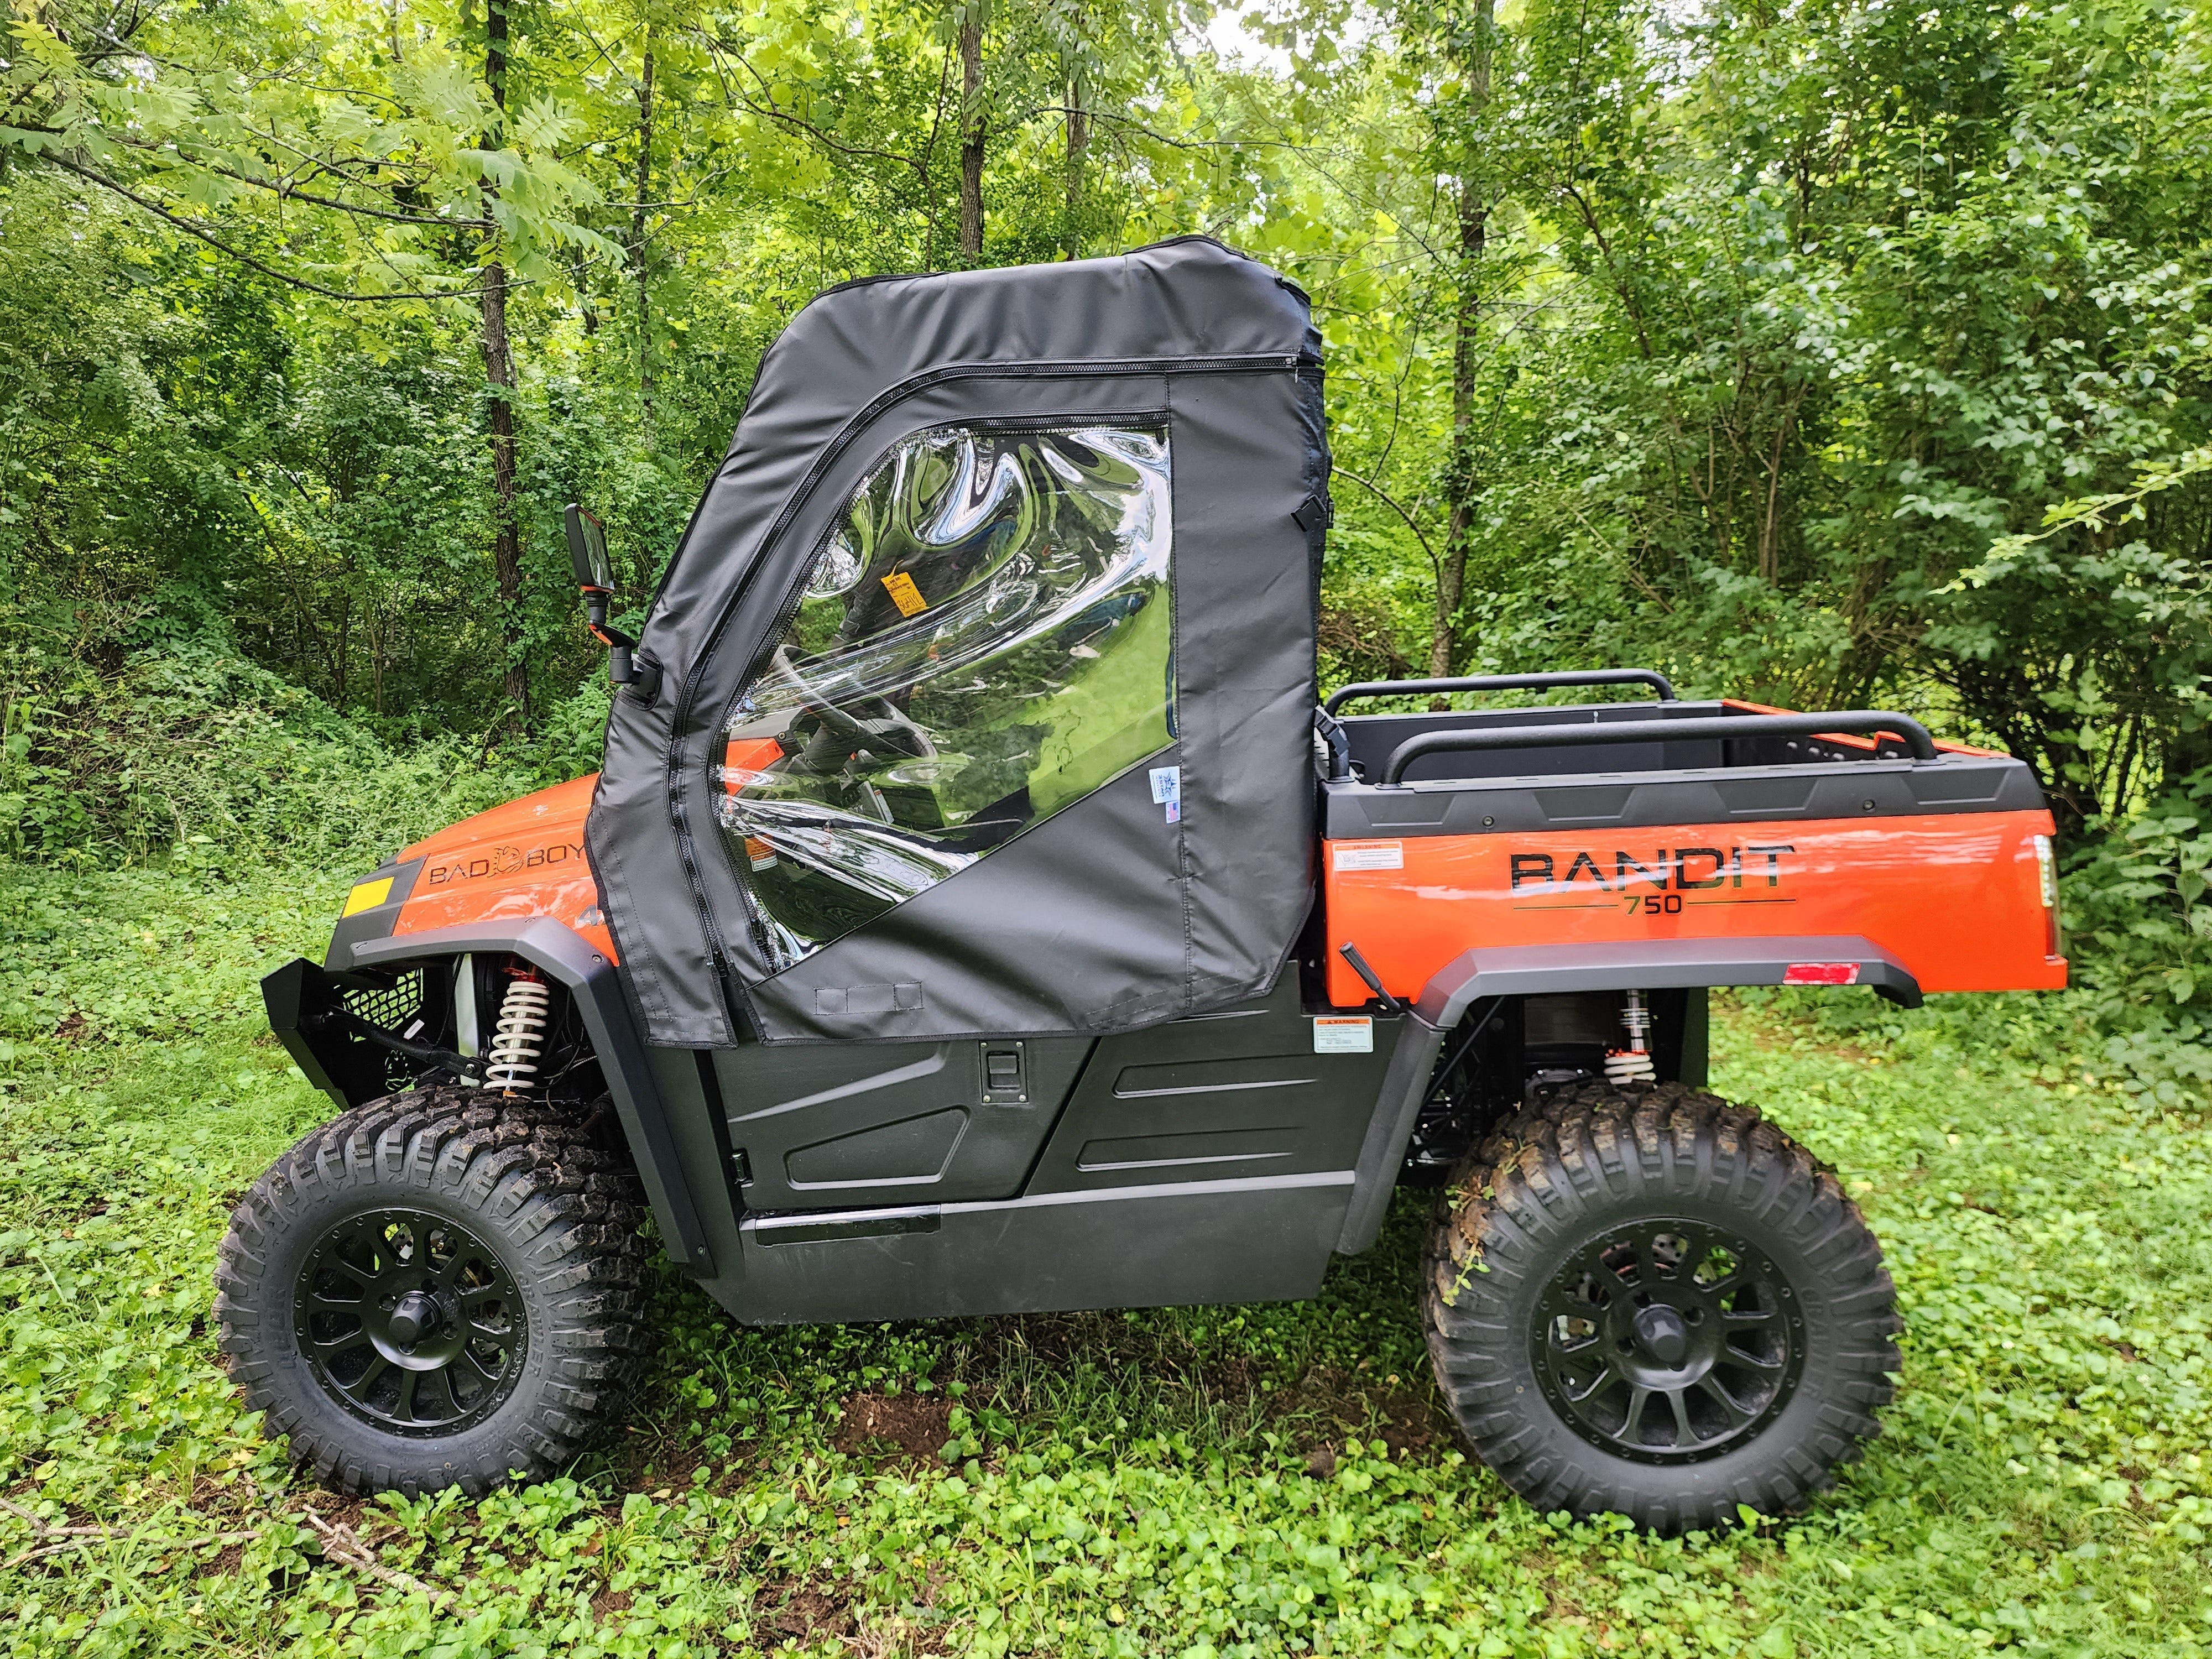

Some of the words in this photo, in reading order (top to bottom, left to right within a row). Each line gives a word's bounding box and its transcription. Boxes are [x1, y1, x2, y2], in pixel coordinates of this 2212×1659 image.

[429, 859, 489, 885] BAD
[526, 843, 586, 868] BOY
[1509, 845, 1797, 895] BANDIT
[1621, 894, 1684, 917] 750
